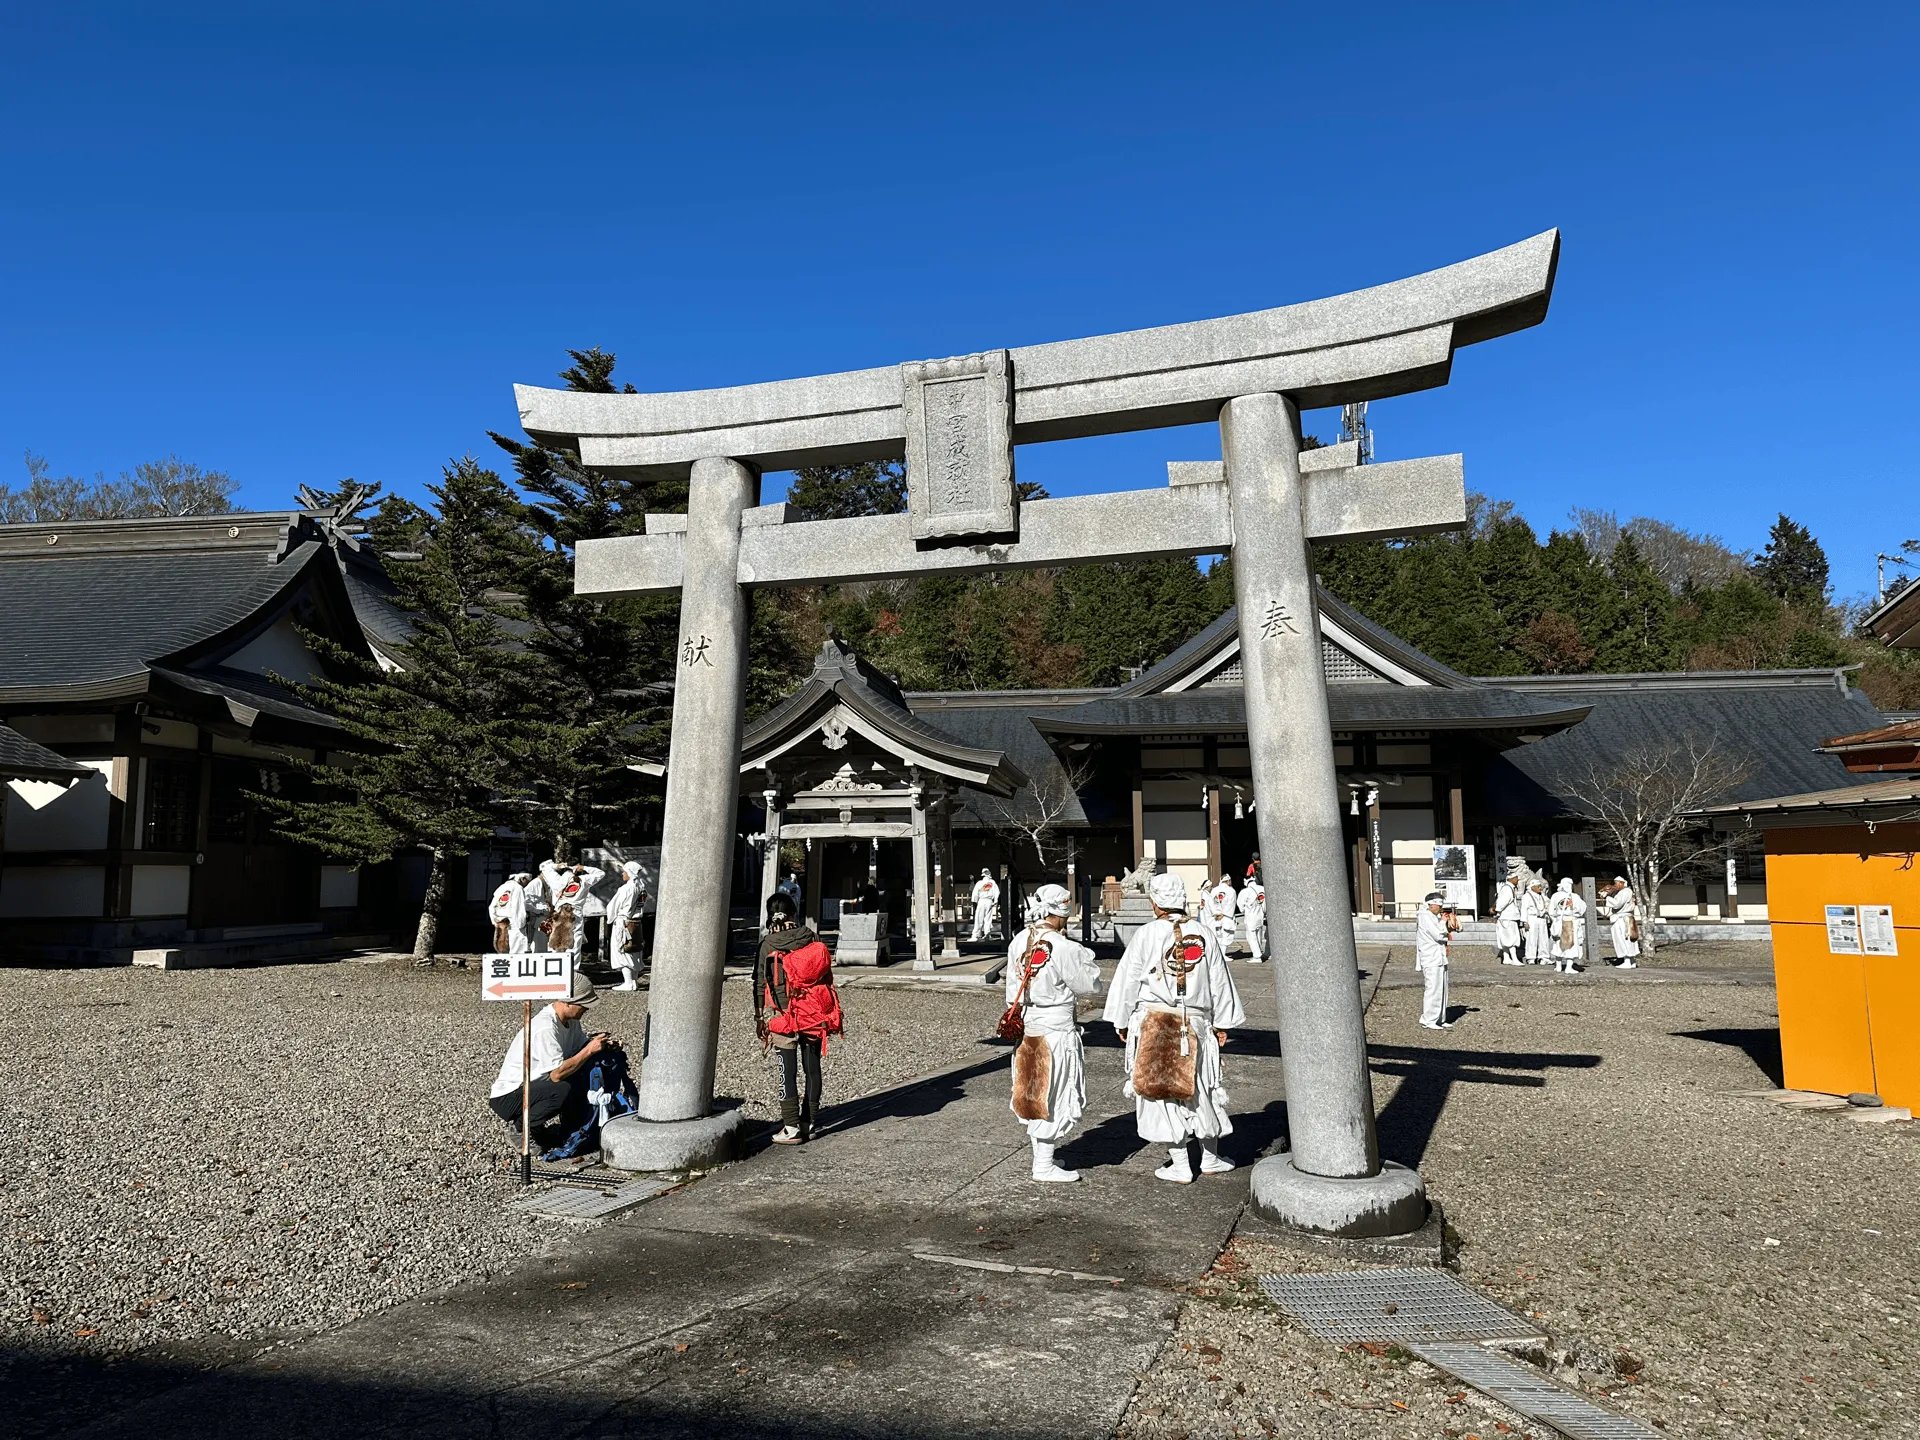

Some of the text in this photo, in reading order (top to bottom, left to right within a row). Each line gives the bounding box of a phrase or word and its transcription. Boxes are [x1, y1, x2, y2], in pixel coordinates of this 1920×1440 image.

[1260, 600, 1302, 643] 奉
[681, 634, 716, 668] 献
[490, 957, 563, 978] 登山口
